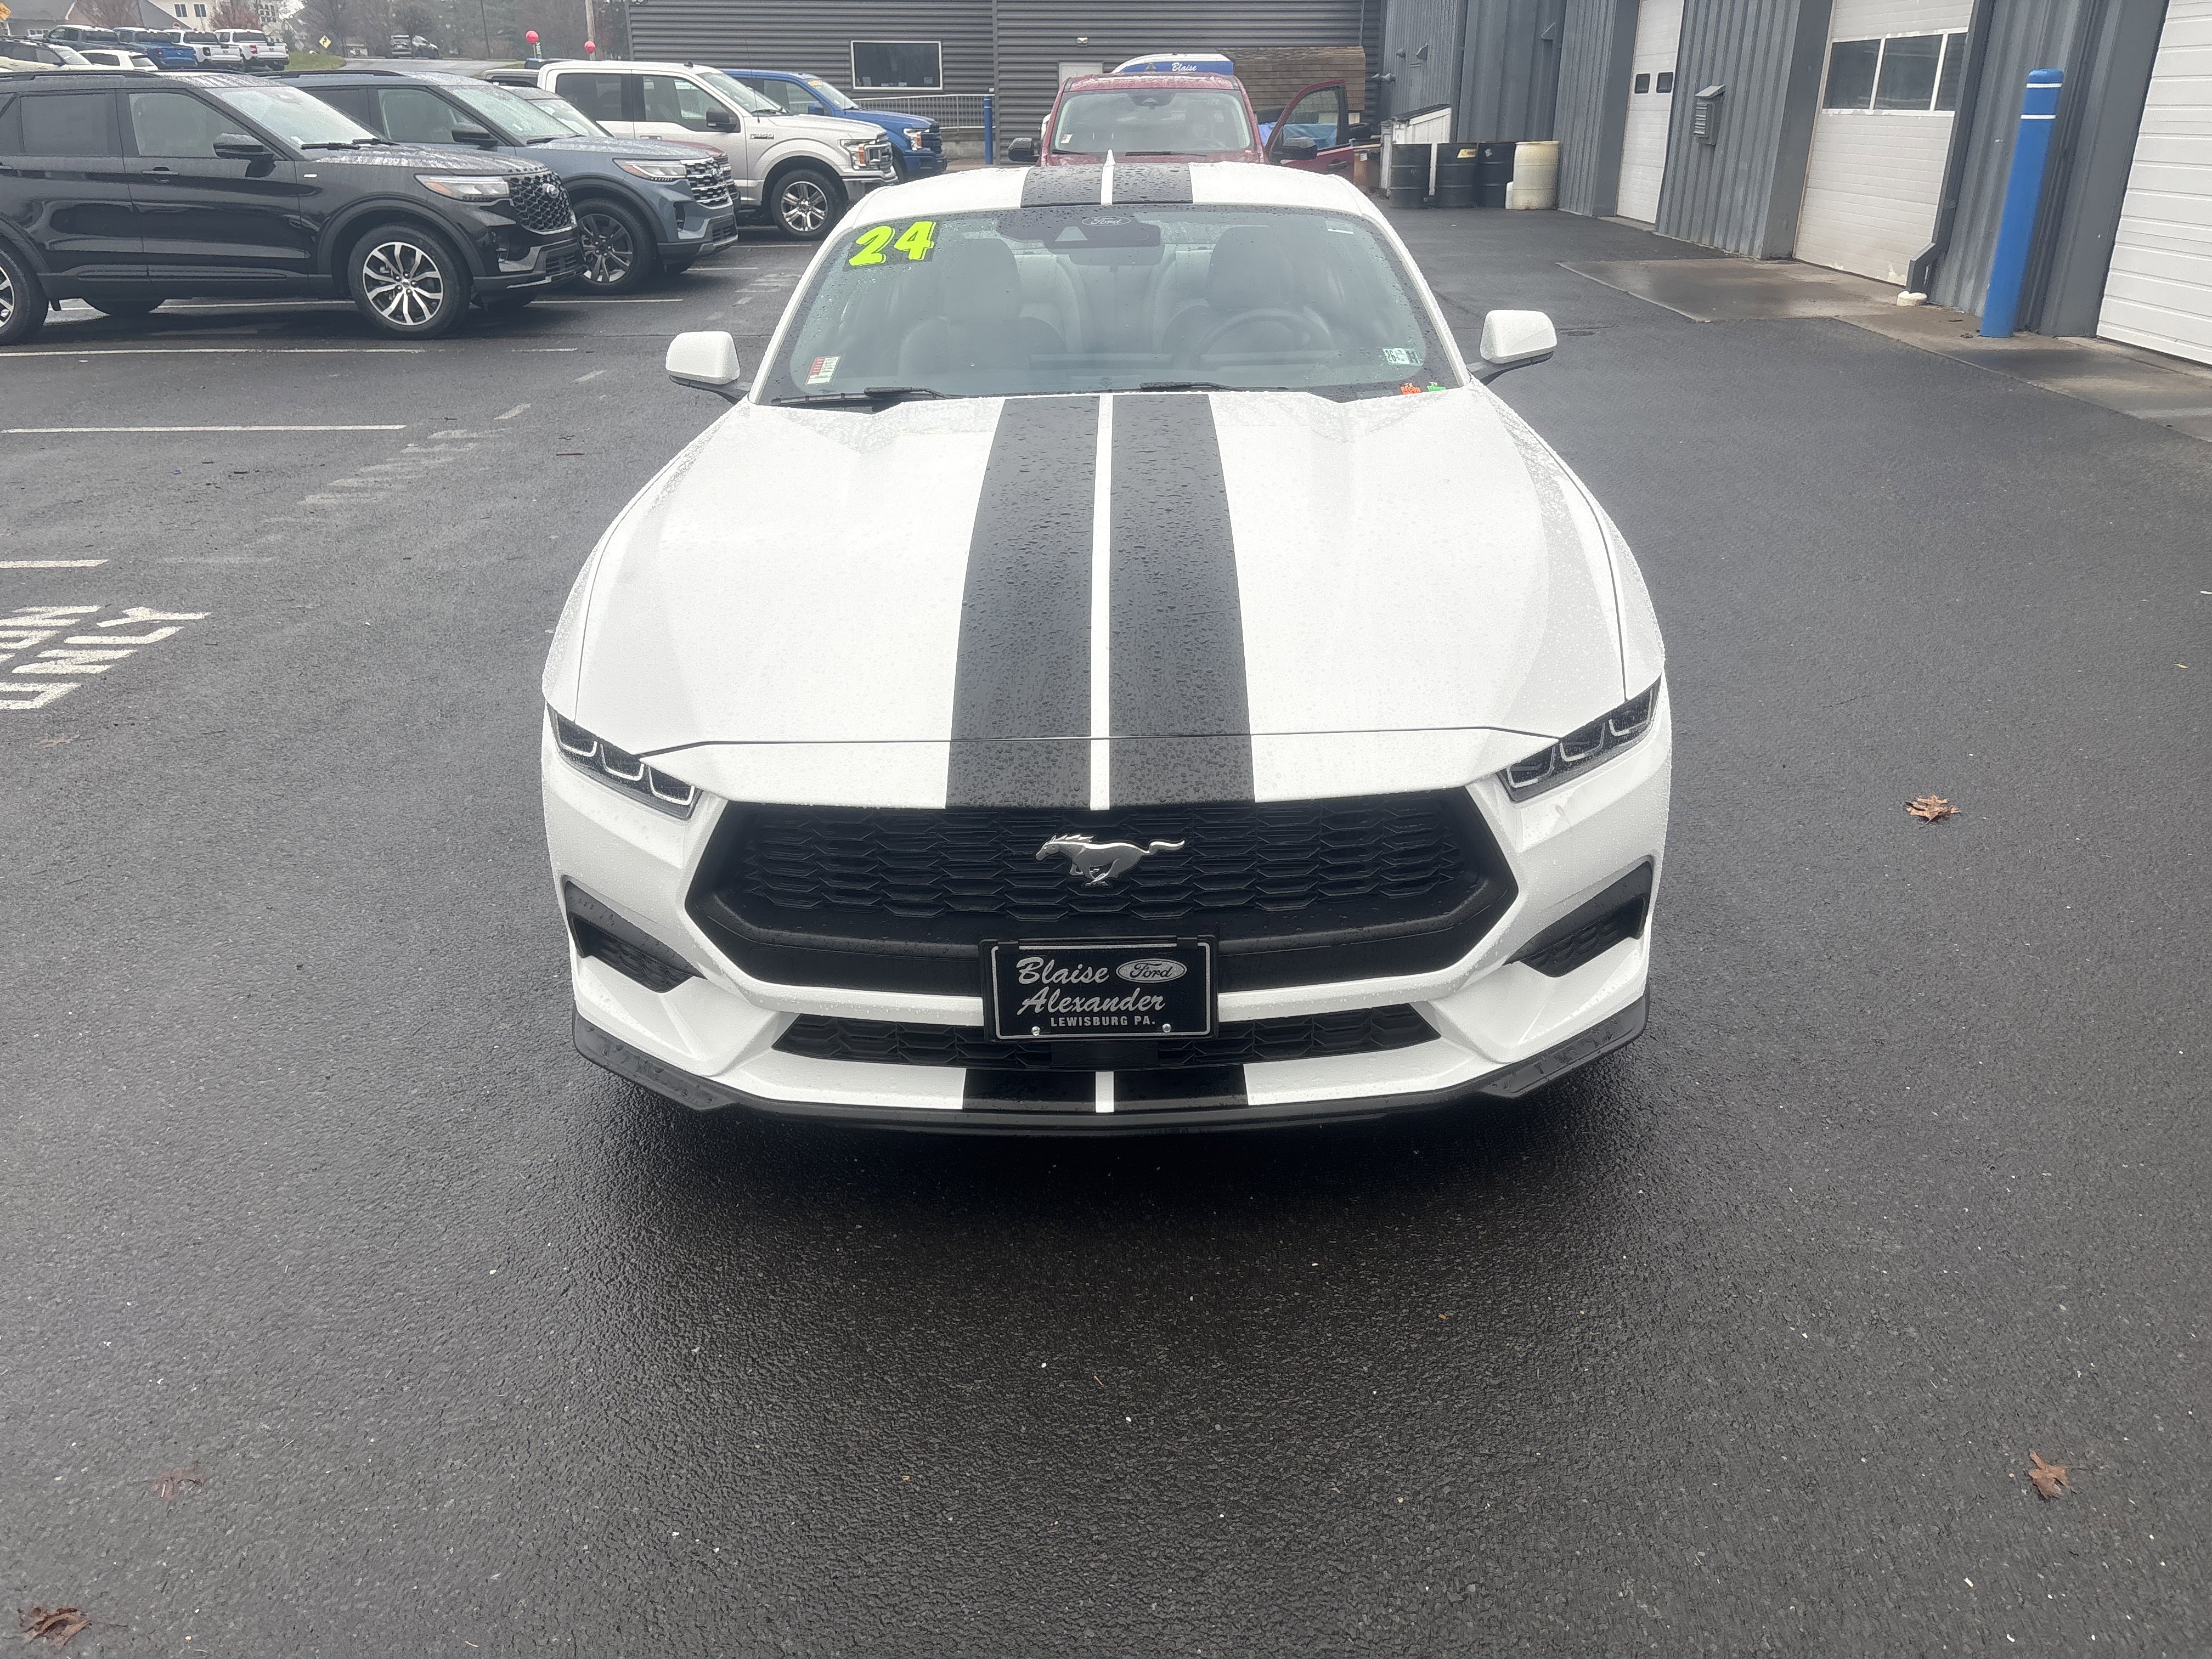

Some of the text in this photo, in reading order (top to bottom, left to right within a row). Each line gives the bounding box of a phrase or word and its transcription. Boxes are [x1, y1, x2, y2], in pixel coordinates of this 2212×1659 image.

[1171, 62, 1197, 72] Blaise
[849, 221, 936, 267] 24
[1015, 956, 1172, 985] Blaise Ford
[1017, 986, 1165, 1015] Alexander
[1051, 1015, 1156, 1027] LEWISBURG PA.
